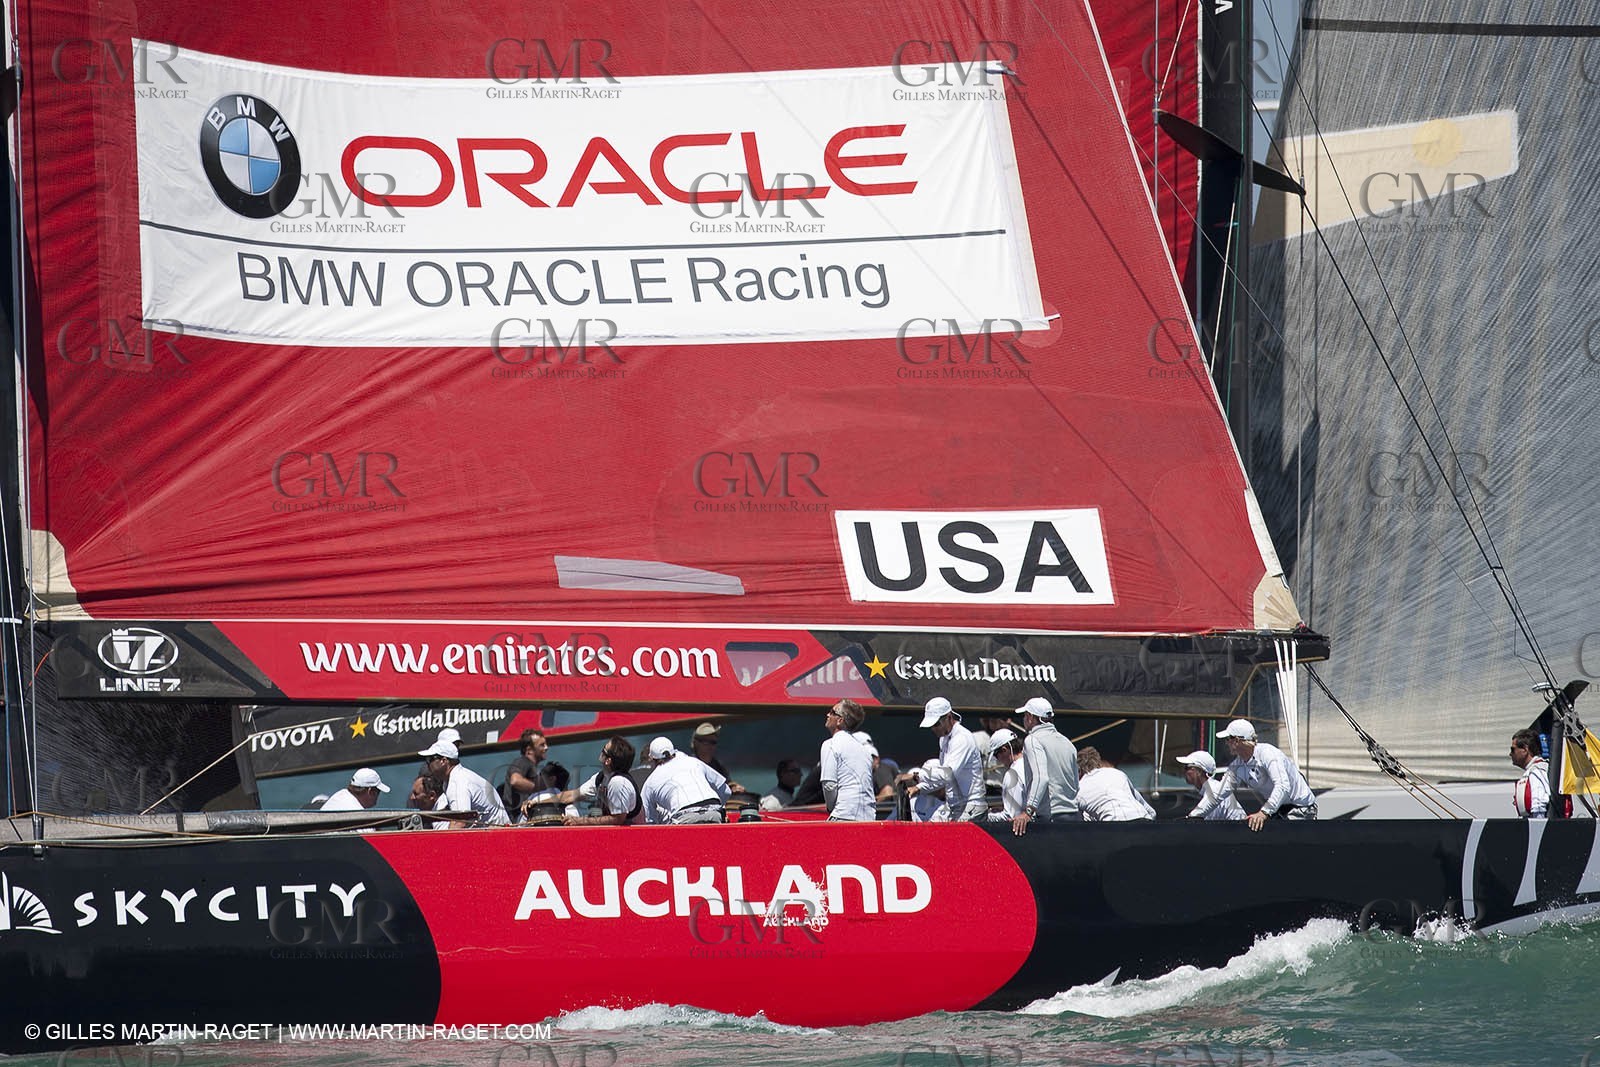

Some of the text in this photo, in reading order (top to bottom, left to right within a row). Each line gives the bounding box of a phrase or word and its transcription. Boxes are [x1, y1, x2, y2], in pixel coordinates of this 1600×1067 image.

[207, 96, 291, 143] BMW
[341, 123, 918, 208] ORACLE
[237, 252, 890, 309] BMW ORACLE Racing
[853, 520, 1094, 593] USA
[299, 636, 722, 679] www.emirates.com
[248, 724, 334, 752] TOYOTA
[73, 881, 367, 928] SKYCITY
[514, 863, 933, 921] AUCKLAND
